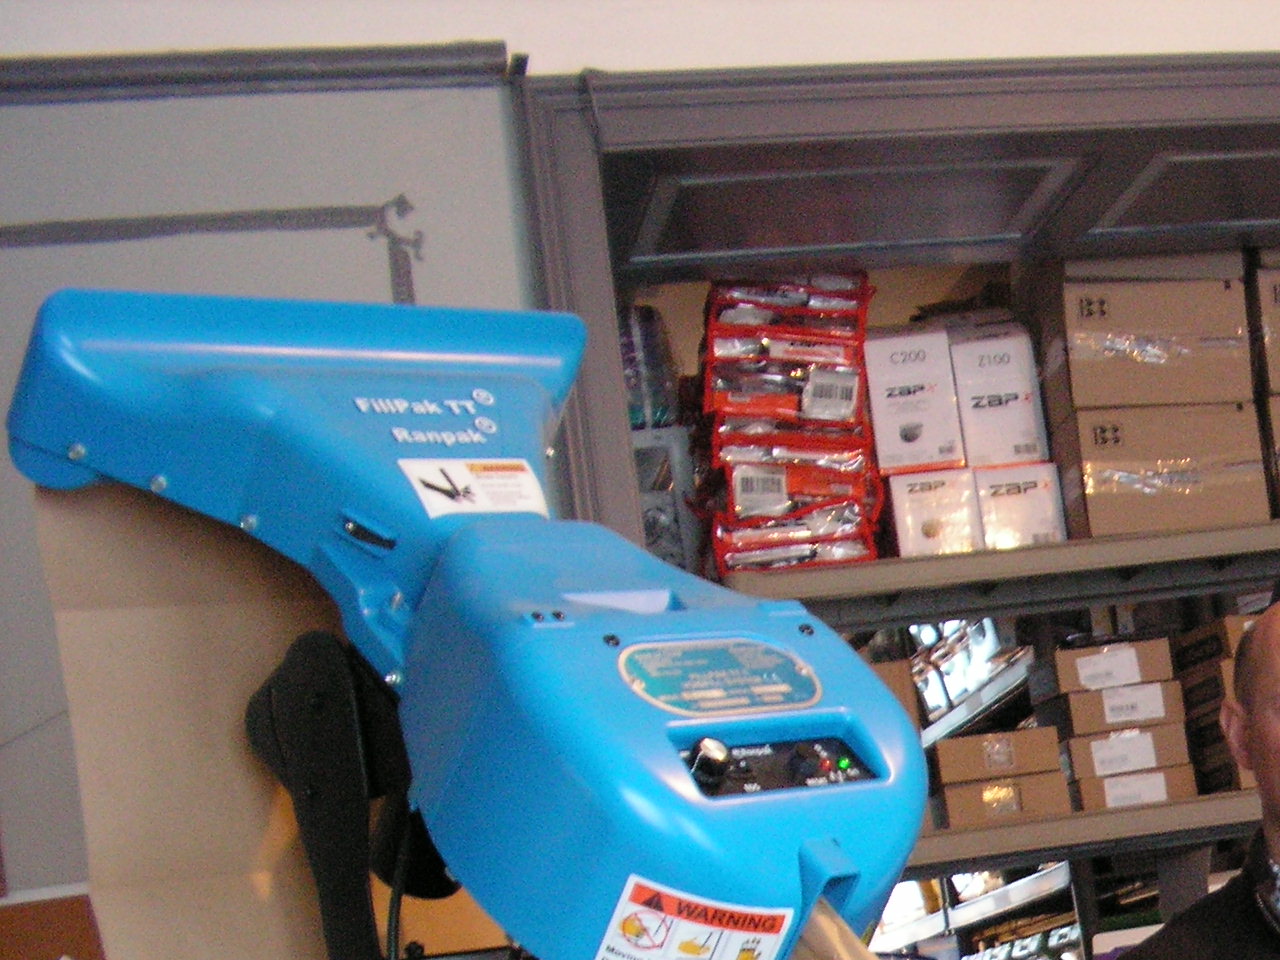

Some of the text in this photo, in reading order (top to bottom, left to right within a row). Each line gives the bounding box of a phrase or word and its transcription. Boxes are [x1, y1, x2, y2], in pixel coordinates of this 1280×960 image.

[889, 350, 927, 365] C200
[354, 397, 444, 415] FillPak
[391, 426, 488, 446] Ranpak
[675, 901, 776, 932] WARNING
